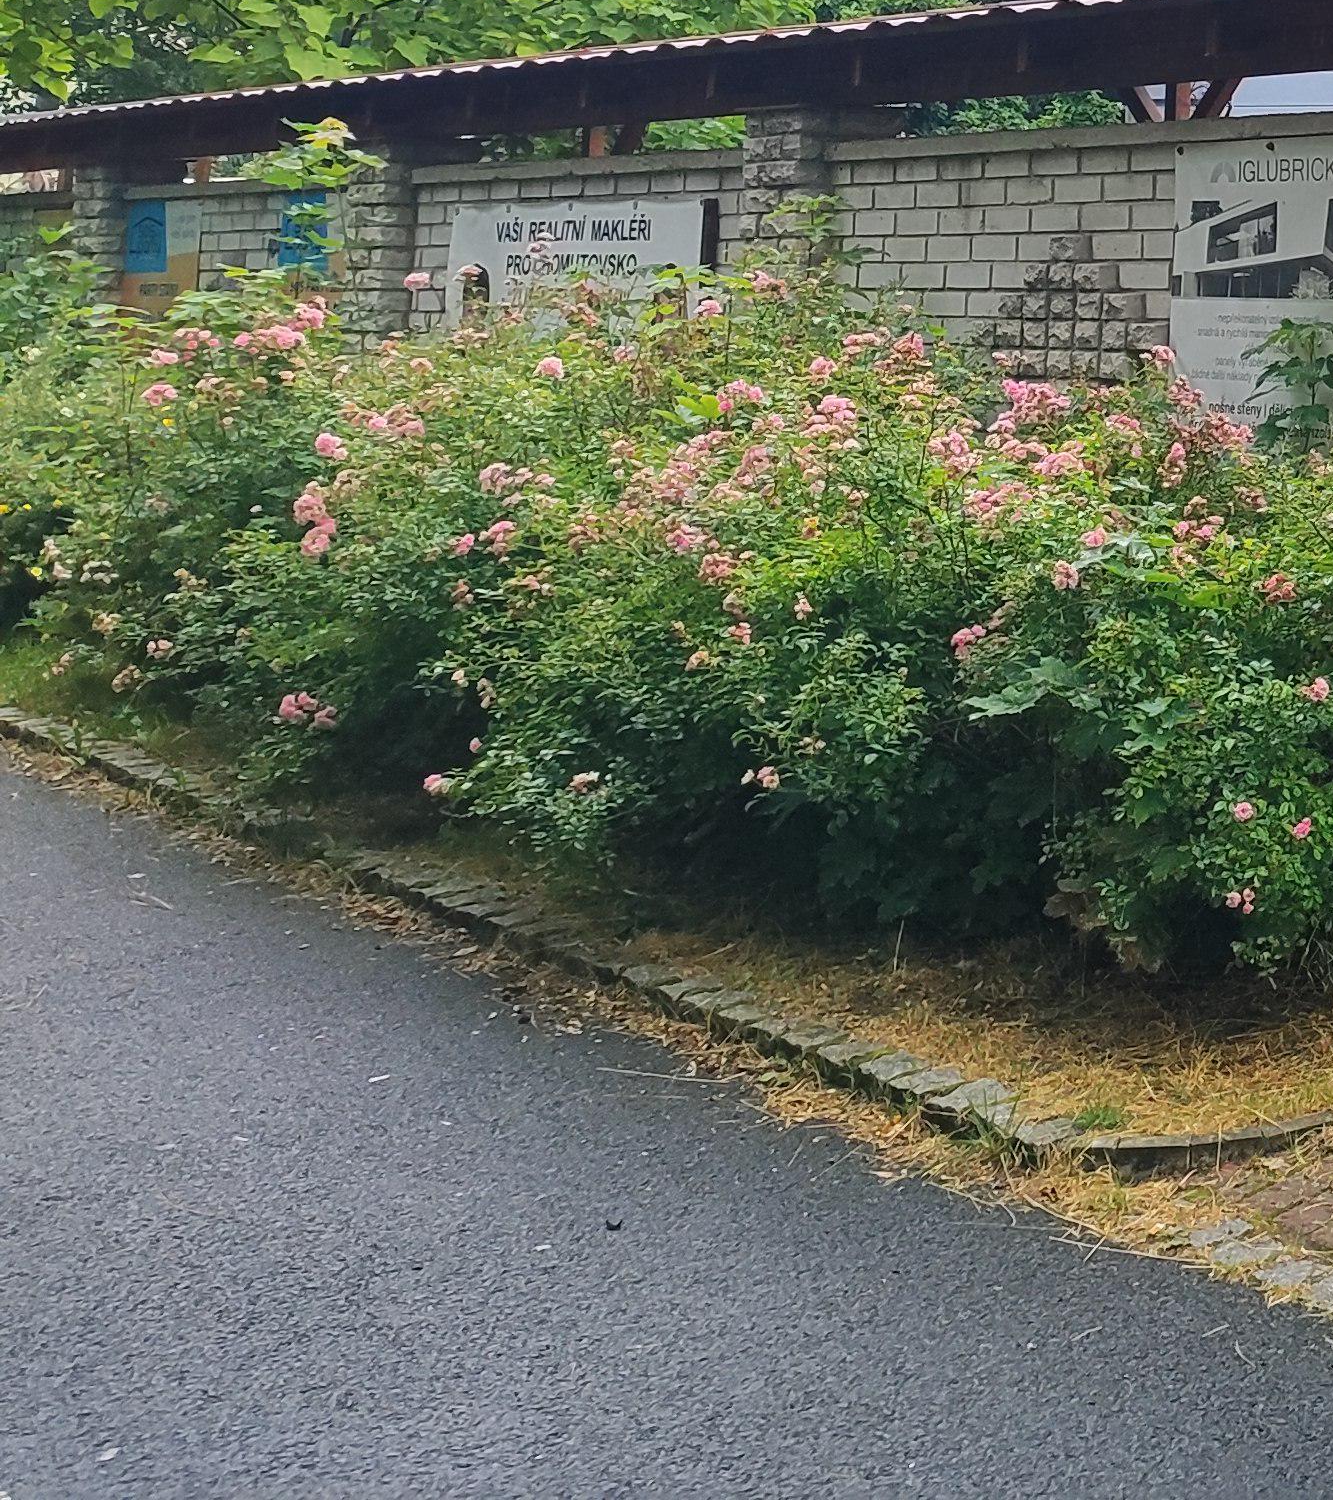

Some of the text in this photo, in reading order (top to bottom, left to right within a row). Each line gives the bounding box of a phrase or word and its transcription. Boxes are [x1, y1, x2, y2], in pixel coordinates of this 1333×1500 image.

[496, 213, 652, 243] VAŠI REALITNÍ MAKLÉŘI
[506, 253, 638, 276] PRO OMUTOVSKO
